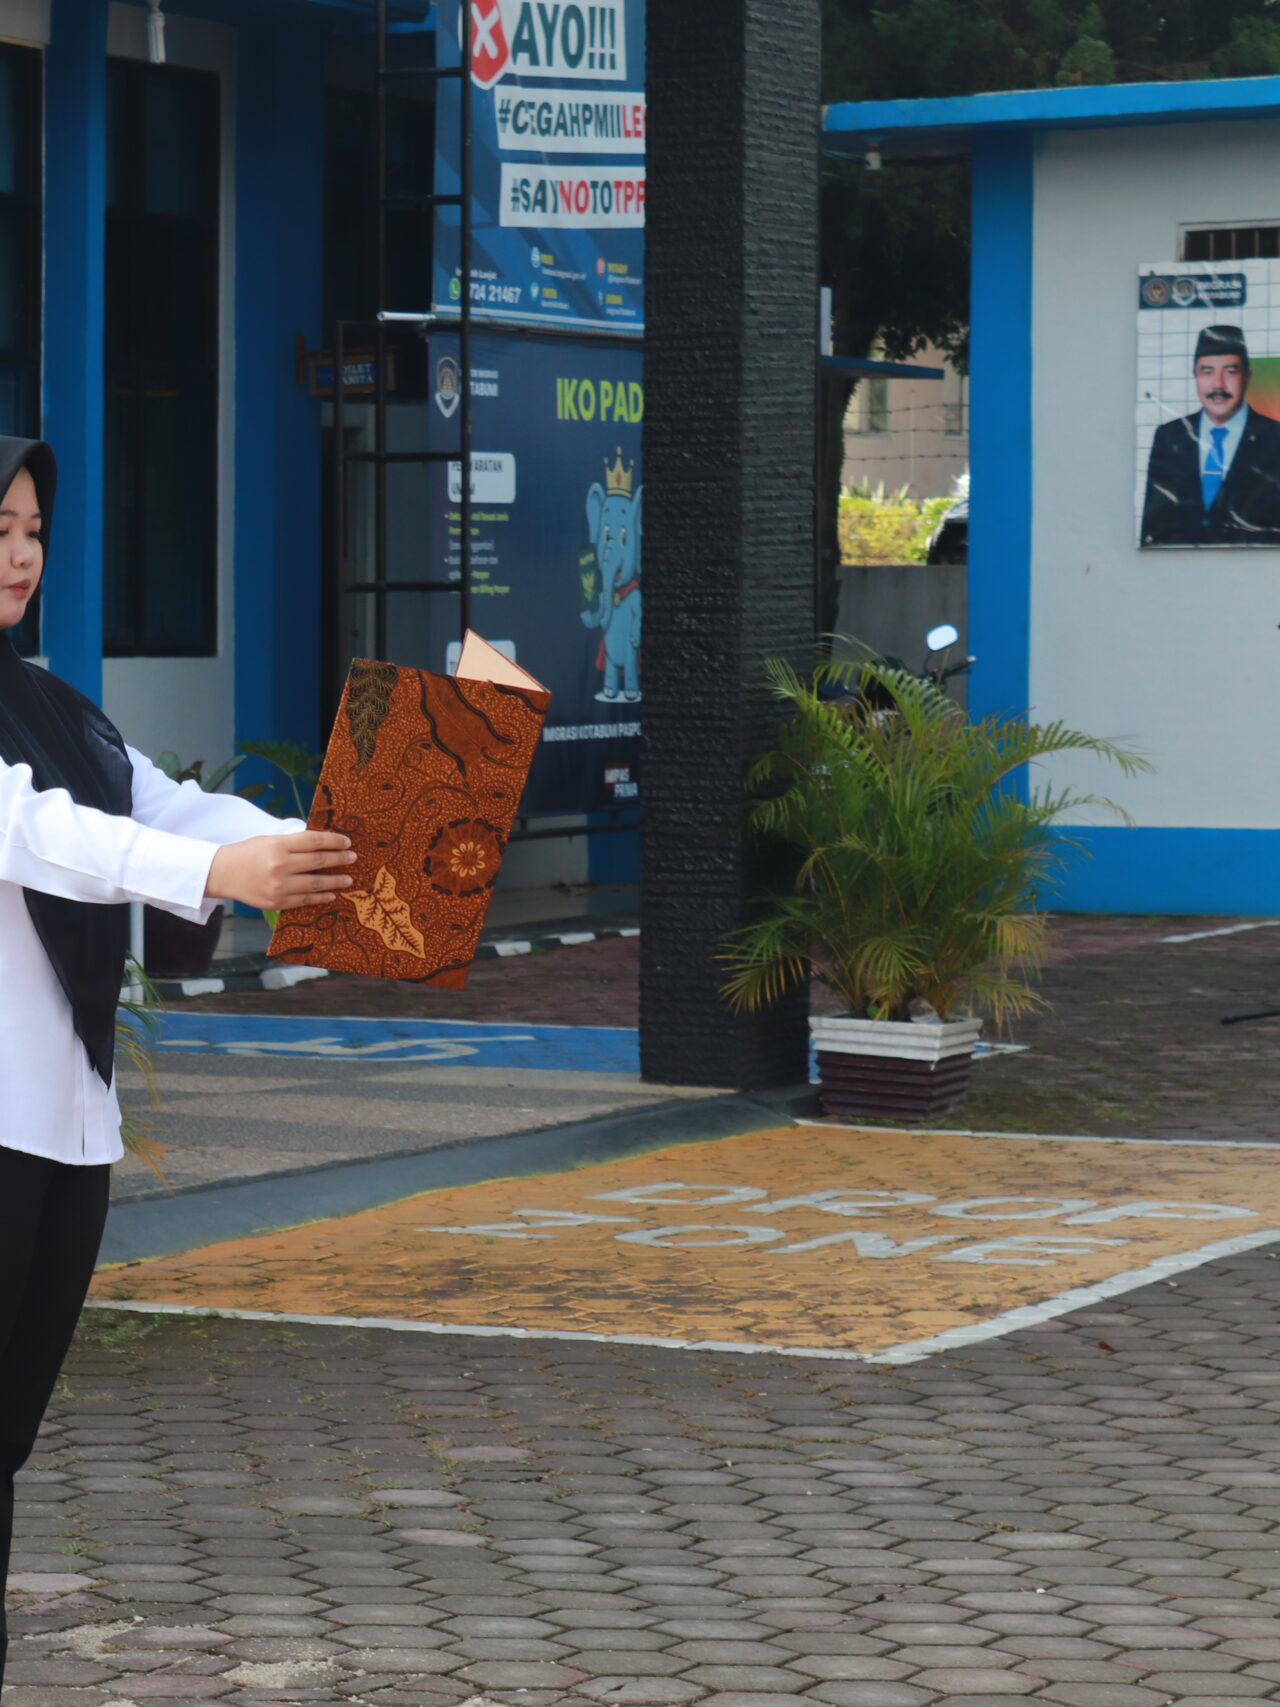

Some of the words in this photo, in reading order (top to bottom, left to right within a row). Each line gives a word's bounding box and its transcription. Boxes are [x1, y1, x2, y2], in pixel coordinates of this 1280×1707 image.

[512, 2, 616, 70] AYO!!!
[585, 1180, 1261, 1226] DROP
[416, 1207, 1131, 1267] ZONE
